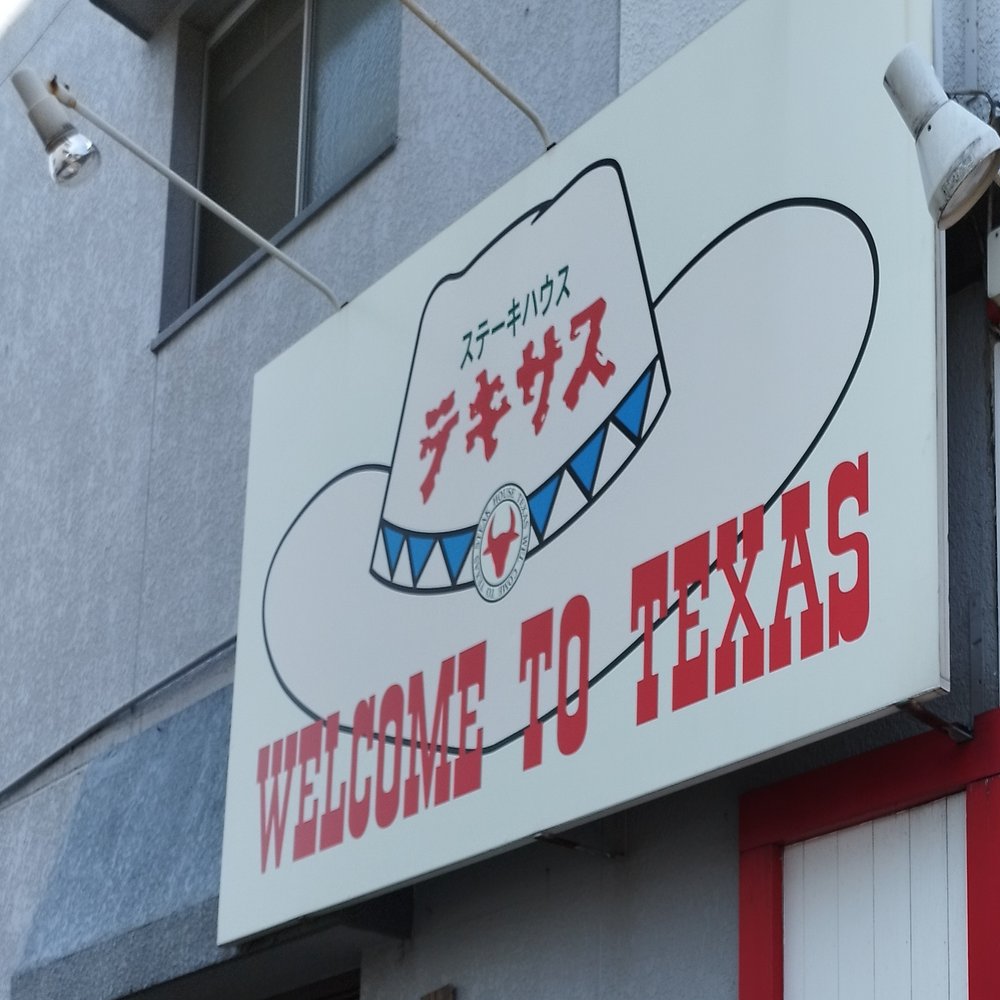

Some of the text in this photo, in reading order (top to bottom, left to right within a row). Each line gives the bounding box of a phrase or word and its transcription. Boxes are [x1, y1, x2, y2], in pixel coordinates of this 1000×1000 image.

[420, 297, 616, 505] テキサス
[459, 265, 571, 370] ステーキハウス
[257, 452, 870, 875] WELCOME TO TEXAS
